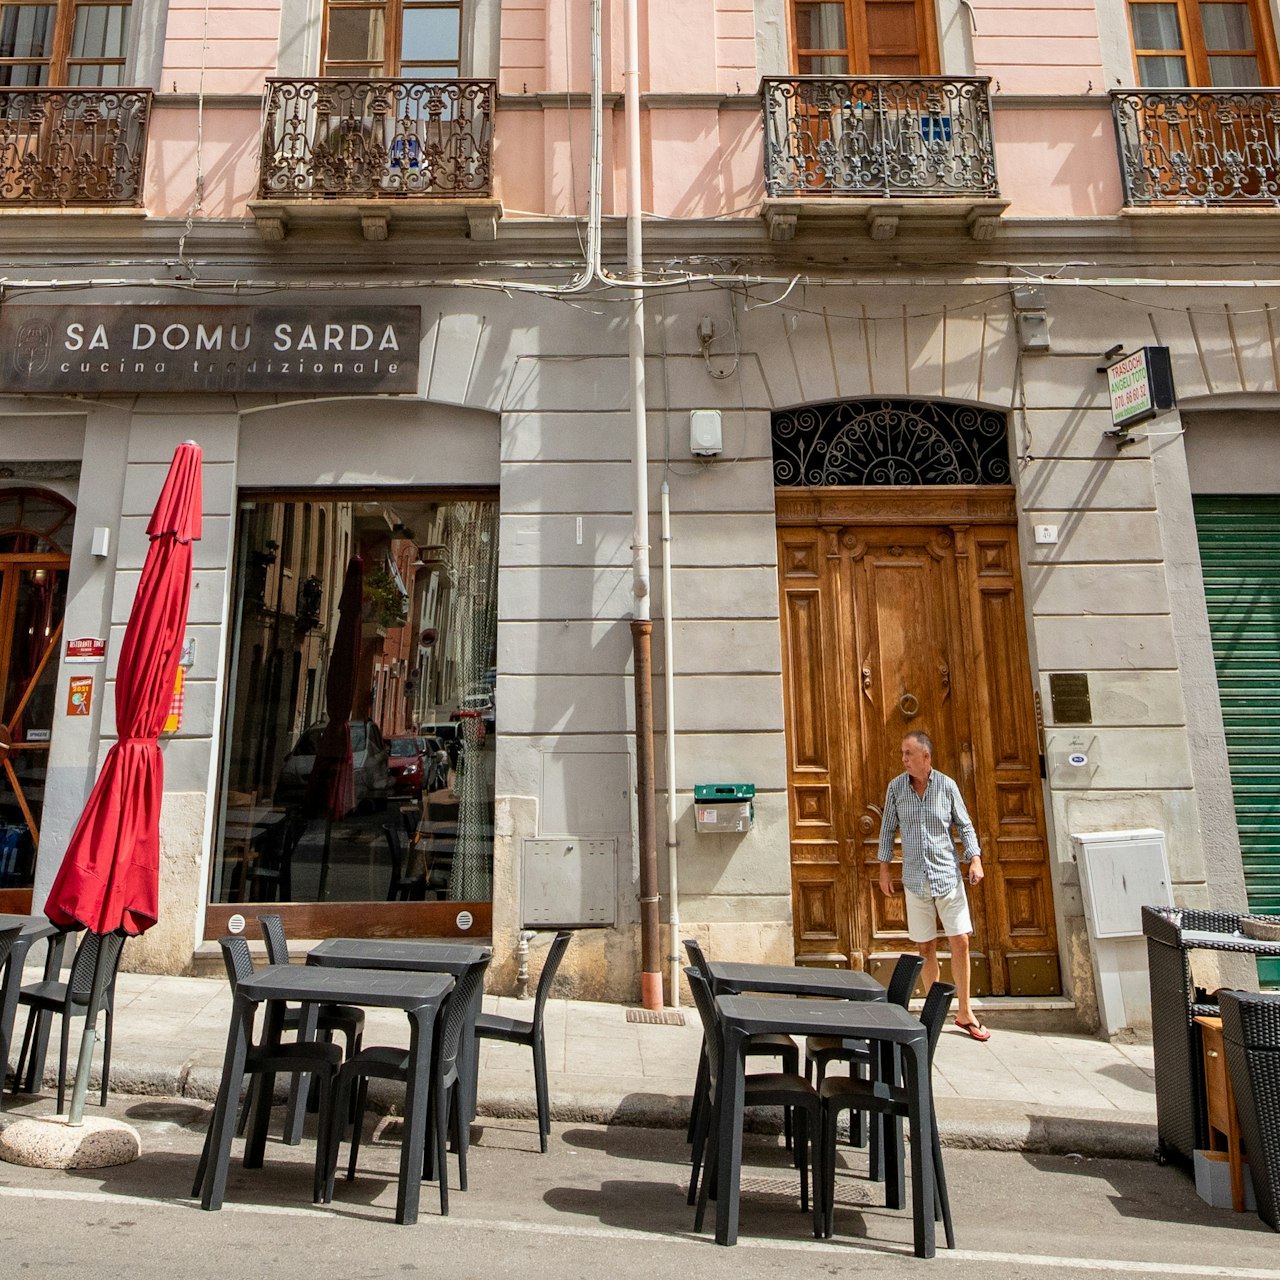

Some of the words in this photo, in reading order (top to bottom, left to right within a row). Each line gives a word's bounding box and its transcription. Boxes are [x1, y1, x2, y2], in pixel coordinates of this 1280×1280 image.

[64, 322, 110, 351] SA
[131, 322, 252, 351] DOMU
[272, 323, 401, 352] SARDA
[60, 358, 166, 374] cucina
[193, 357, 400, 374] tradizionale
[1111, 355, 1143, 379] TRASLOCHI
[1111, 375, 1132, 394] ANGELI
[1132, 367, 1147, 384] TOTO
